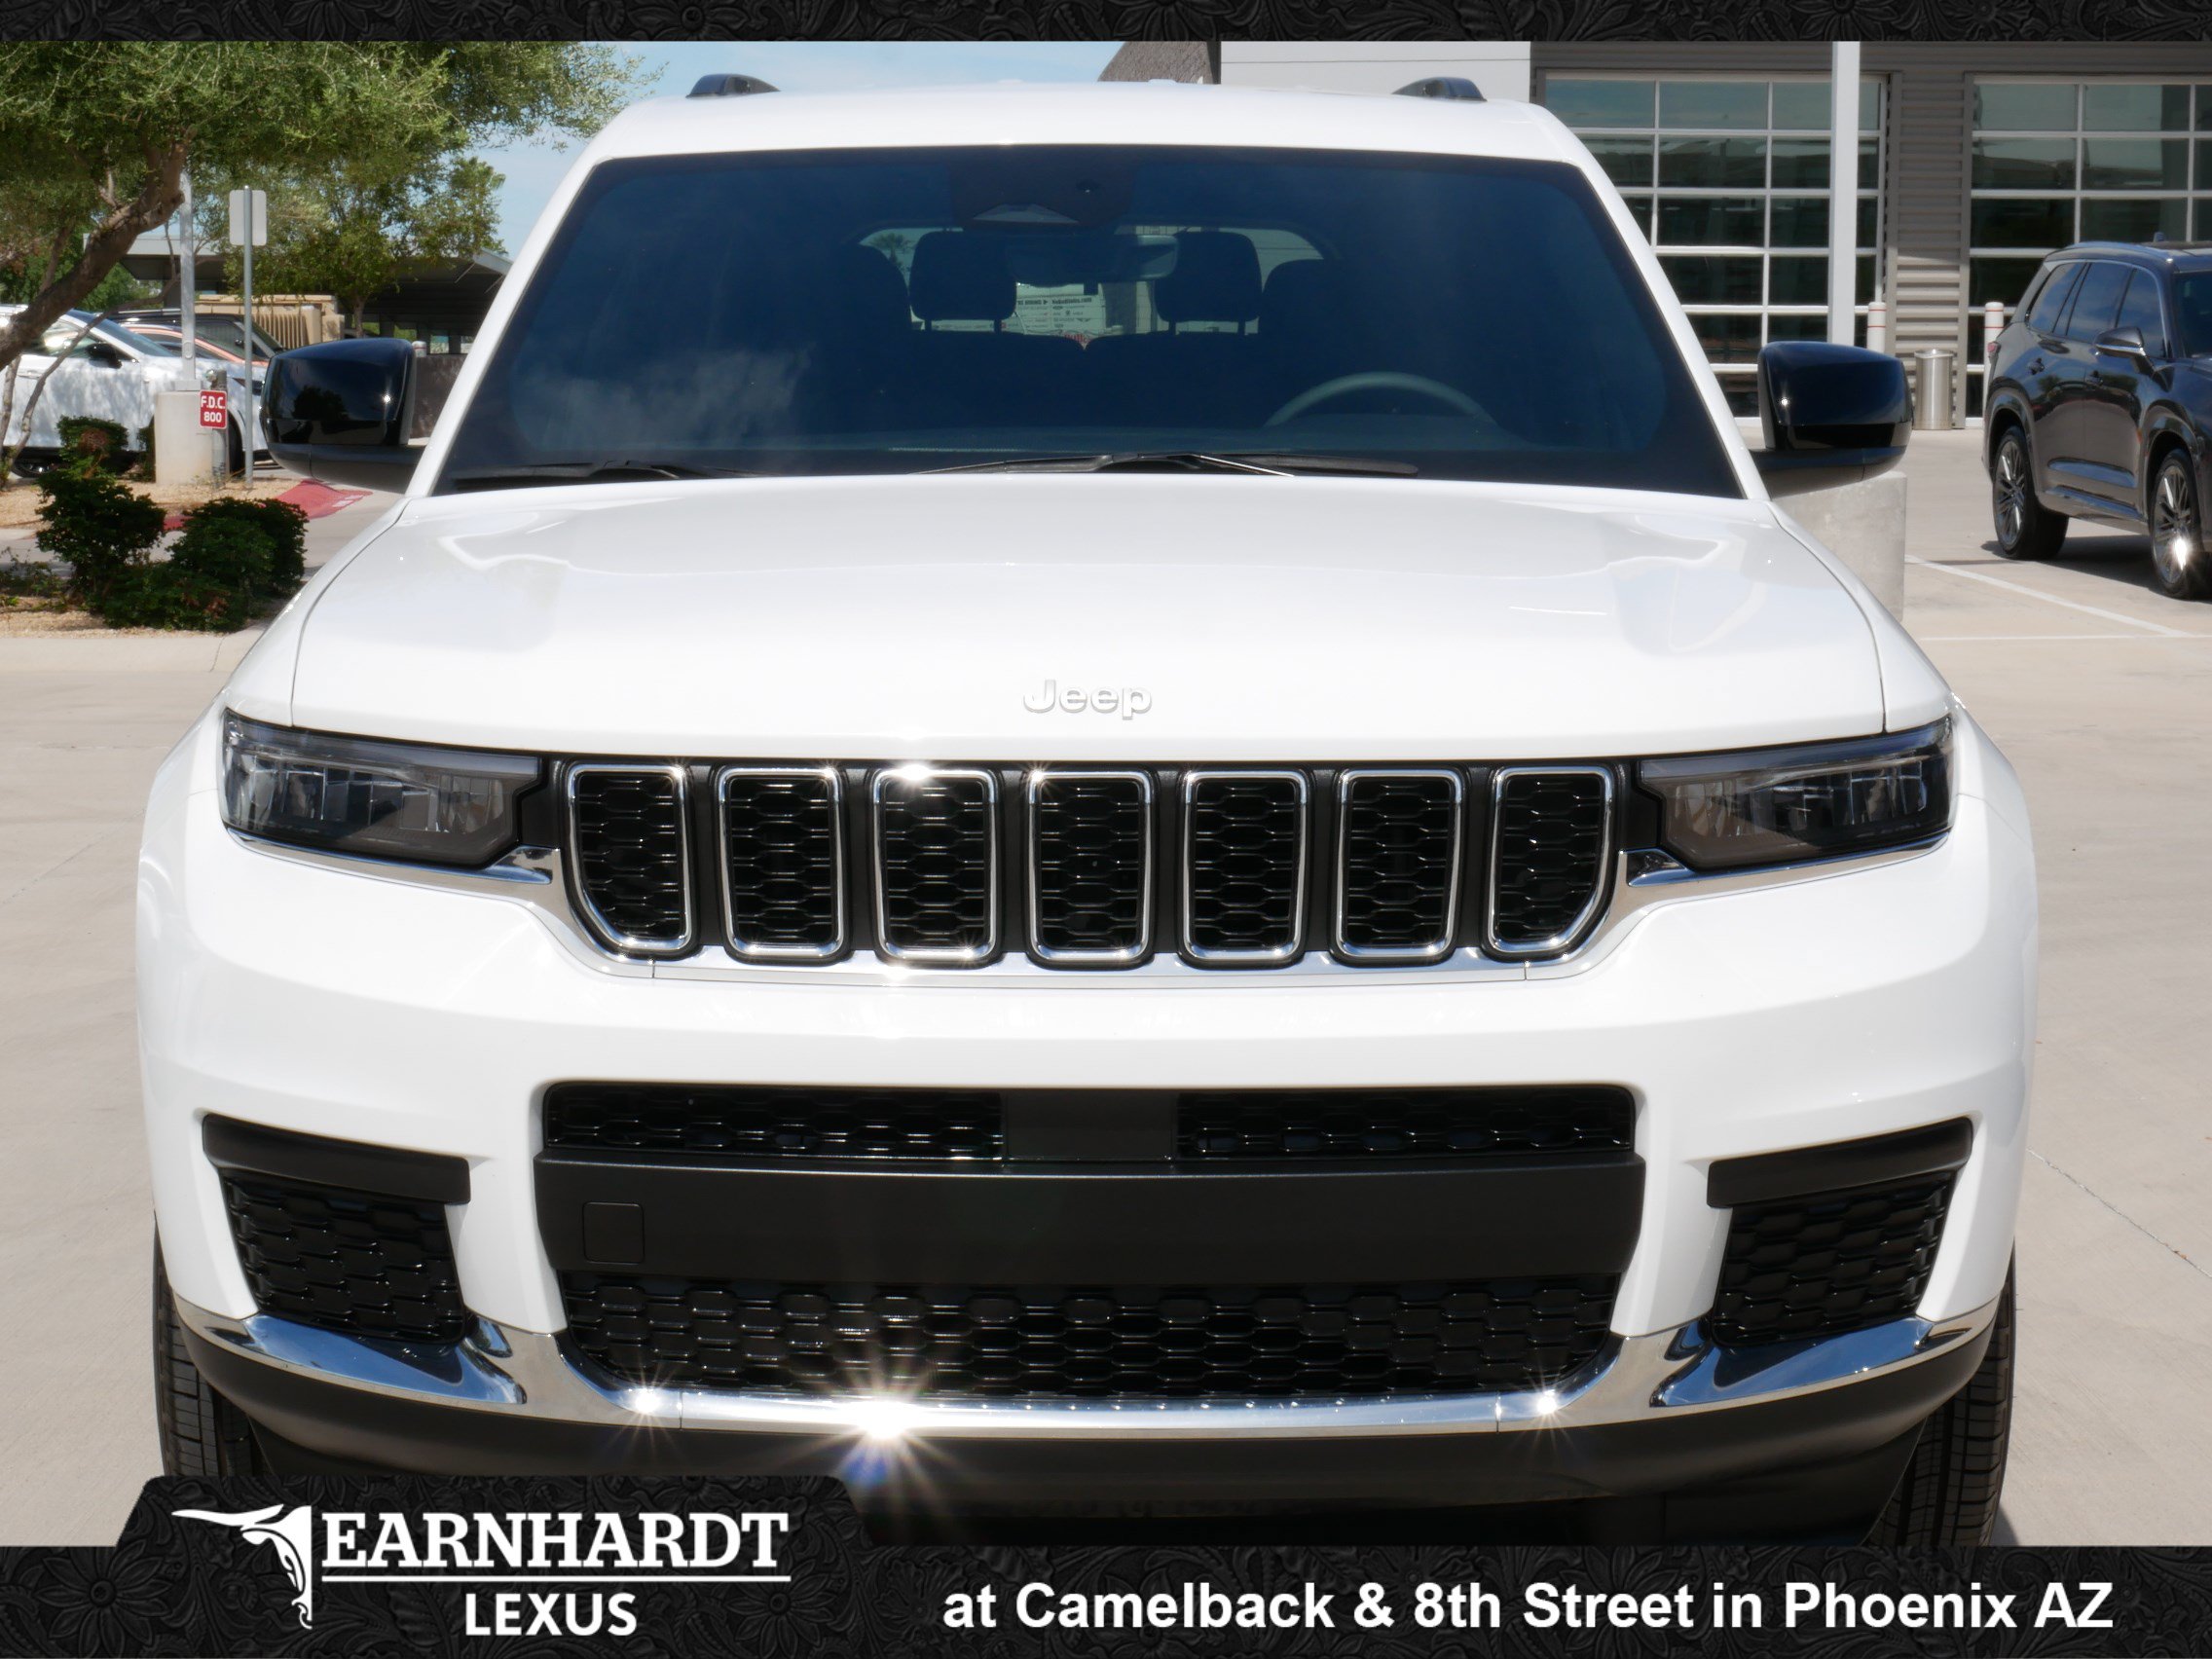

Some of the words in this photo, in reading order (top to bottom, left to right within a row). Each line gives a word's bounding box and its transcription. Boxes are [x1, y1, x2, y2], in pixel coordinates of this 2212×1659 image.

[201, 395, 226, 409] F.D.C.
[203, 411, 222, 423] 800
[1023, 679, 1152, 720] Jeep
